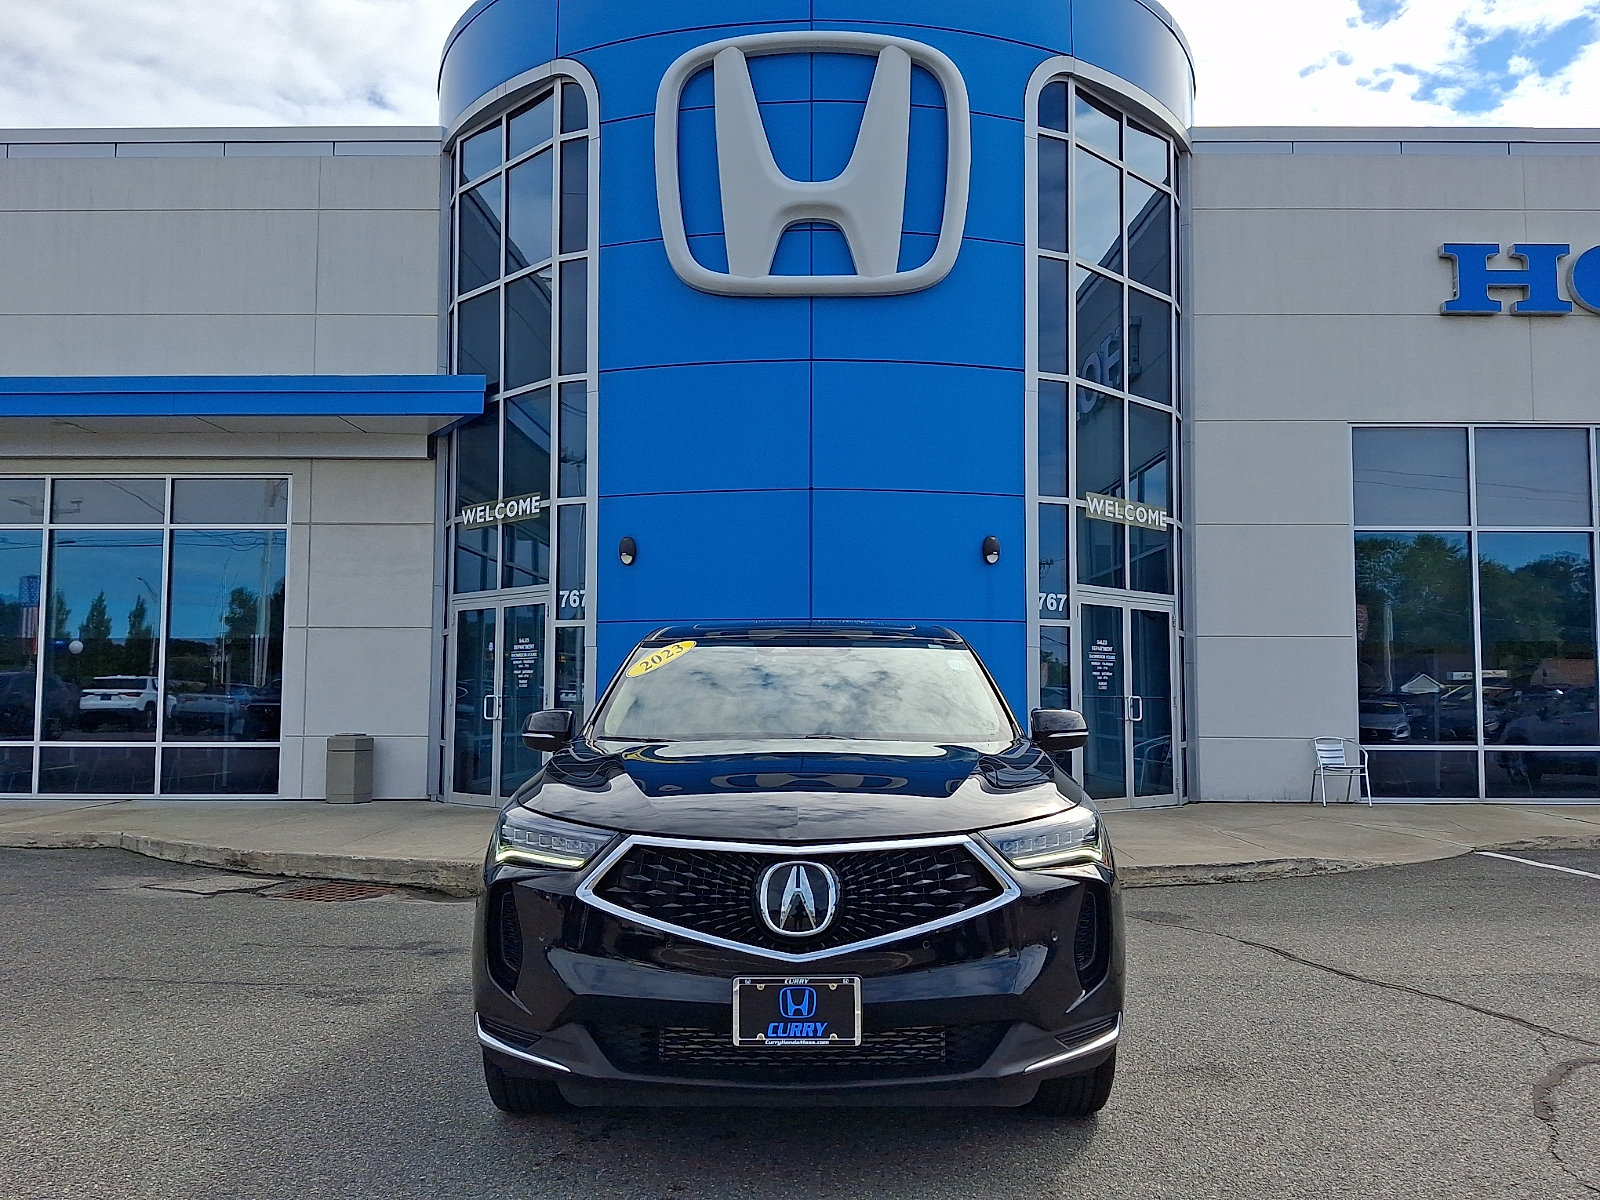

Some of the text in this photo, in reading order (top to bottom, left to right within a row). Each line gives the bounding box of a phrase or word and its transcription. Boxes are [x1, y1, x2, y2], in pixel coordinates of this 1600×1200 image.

[461, 496, 540, 525] WELCOME
[1085, 496, 1168, 528] WELCOME
[559, 590, 586, 608] 767
[1038, 592, 1067, 612] 767
[639, 644, 684, 672] 2023
[767, 1022, 829, 1037] CURRY
